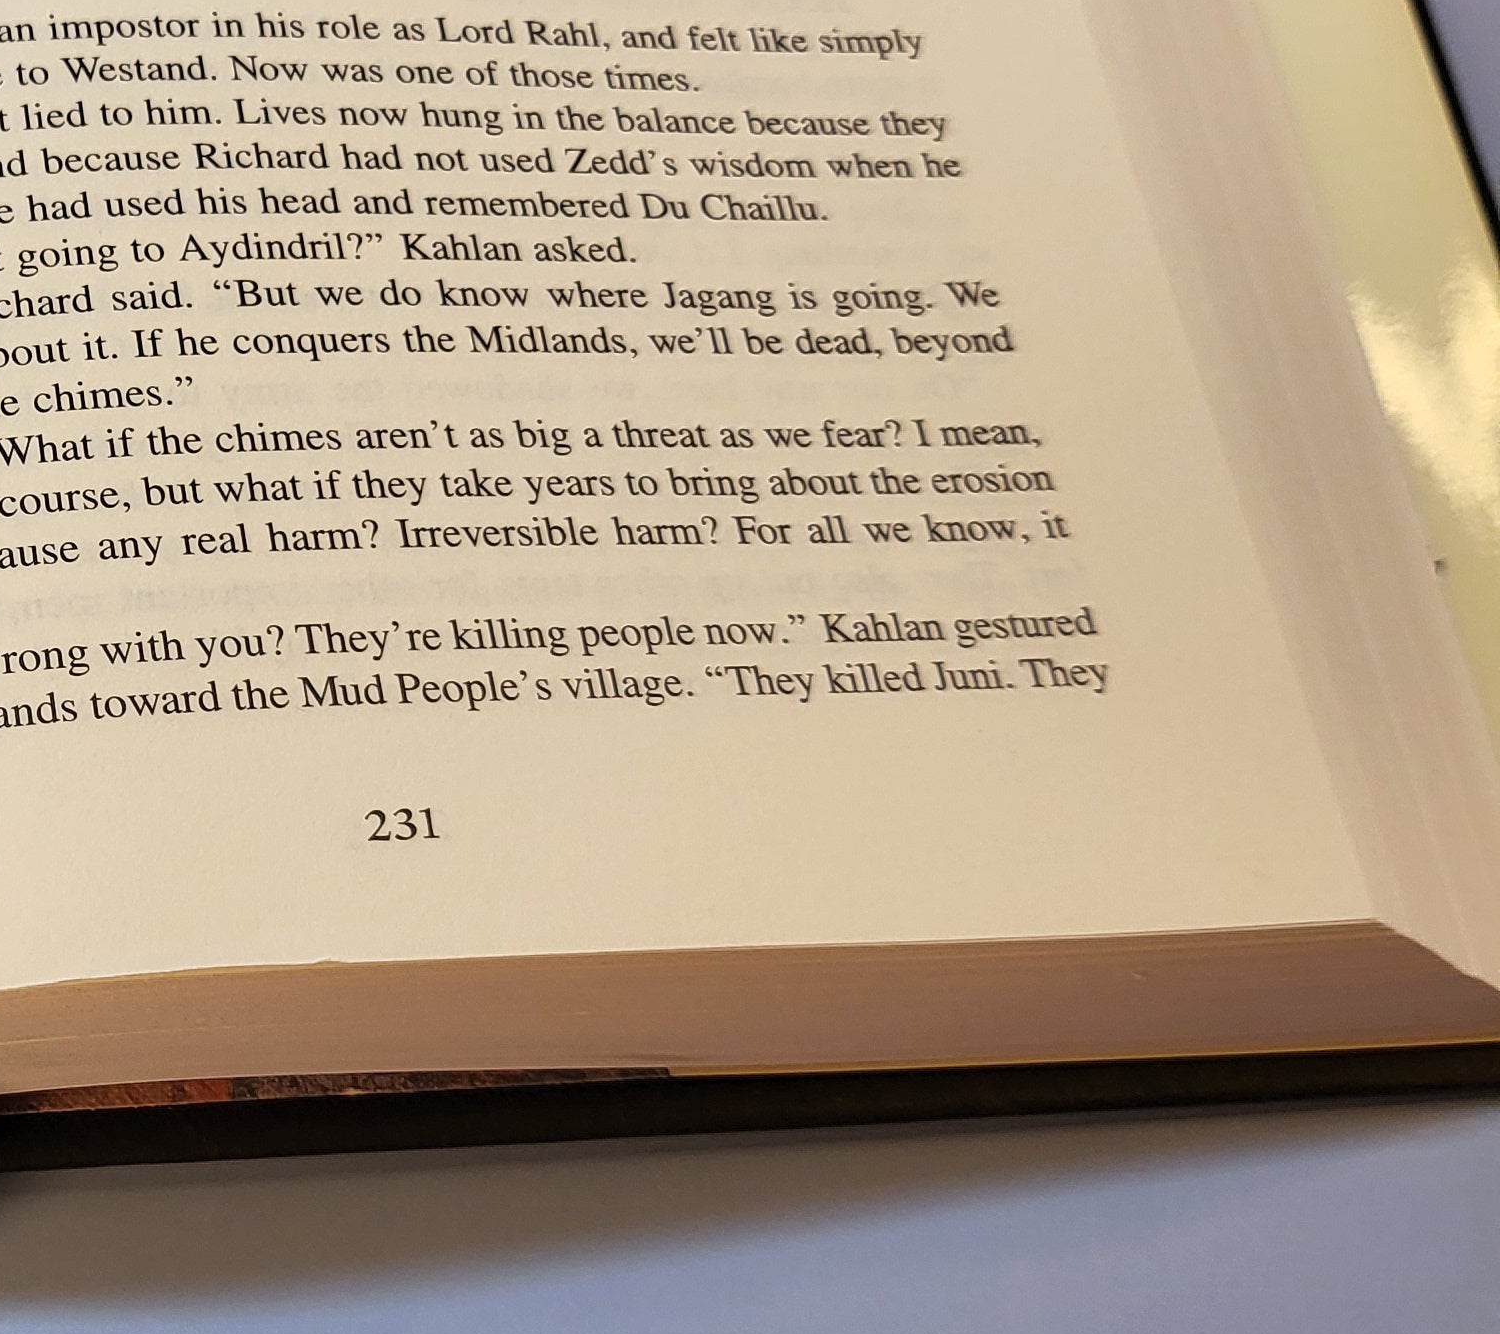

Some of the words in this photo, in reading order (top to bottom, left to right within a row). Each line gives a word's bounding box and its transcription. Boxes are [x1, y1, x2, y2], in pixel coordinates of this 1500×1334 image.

[48, 13, 200, 47] impostor
[211, 11, 246, 38] in
[254, 11, 305, 39] his
[315, 13, 381, 40] role
[392, 22, 426, 42] as
[434, 16, 516, 45] Lord
[523, 20, 611, 52] Rahl,
[621, 25, 679, 50] and
[687, 25, 741, 52] felt
[747, 27, 809, 53] like
[818, 28, 922, 61] simply
[99, 629, 187, 666] with
[194, 624, 284, 669] you?
[294, 620, 443, 662] They’re
[449, 615, 570, 657] killing
[580, 620, 697, 657] people
[702, 613, 805, 645] now.”
[820, 612, 947, 644] Kahlan
[954, 606, 1099, 649] gestured
[89, 680, 223, 720] toward
[230, 678, 290, 711] the
[298, 673, 388, 708] Mud
[395, 669, 553, 712] People’s
[560, 667, 695, 707] village.
[704, 664, 815, 704] “They
[822, 661, 927, 694] killed
[931, 662, 1015, 691] Juni.
[1030, 656, 1108, 694] They
[364, 806, 441, 842] 231
